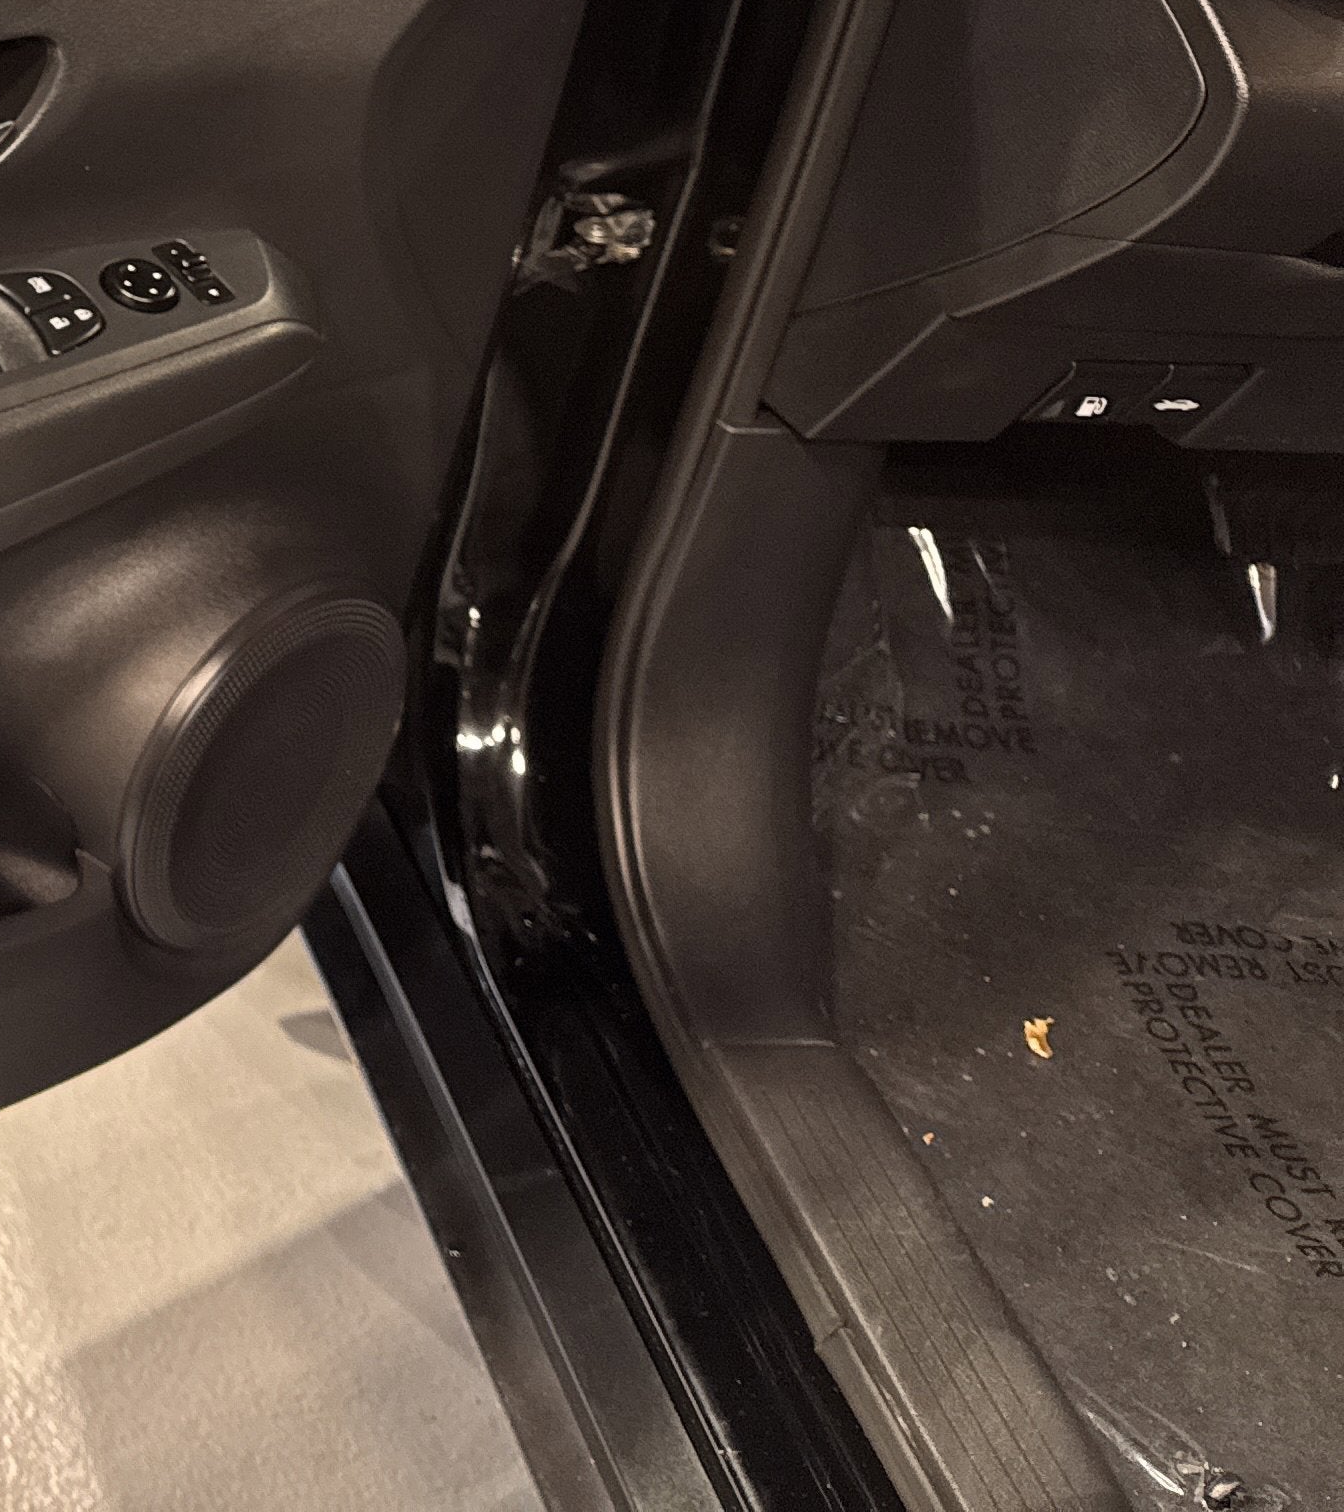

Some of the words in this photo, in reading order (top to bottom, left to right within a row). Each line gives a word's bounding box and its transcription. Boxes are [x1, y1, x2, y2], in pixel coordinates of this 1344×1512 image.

[1106, 951, 1268, 982] REMOVE
[1170, 921, 1294, 954] COVER
[1123, 980, 1261, 1160] PROTECTIVE
[1249, 1172, 1344, 1278] COVER
[1165, 982, 1256, 1093] DEALER
[1247, 1112, 1336, 1201] MUST
